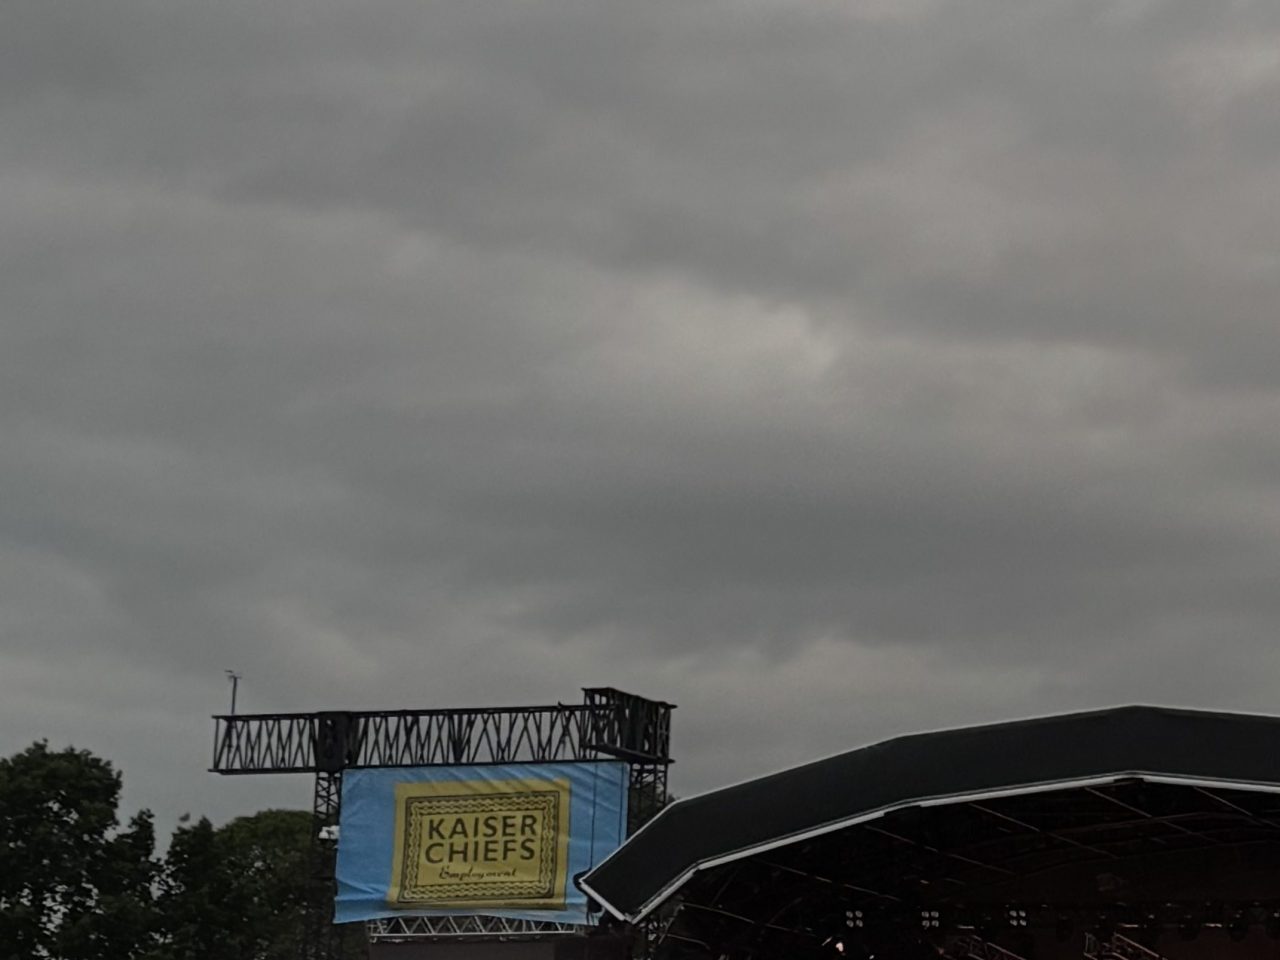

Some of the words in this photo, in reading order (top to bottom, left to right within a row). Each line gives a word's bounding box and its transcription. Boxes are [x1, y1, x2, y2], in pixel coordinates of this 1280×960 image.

[428, 815, 538, 841] KAISER
[425, 838, 536, 864] CHIEFS
[439, 865, 517, 882] Employment
